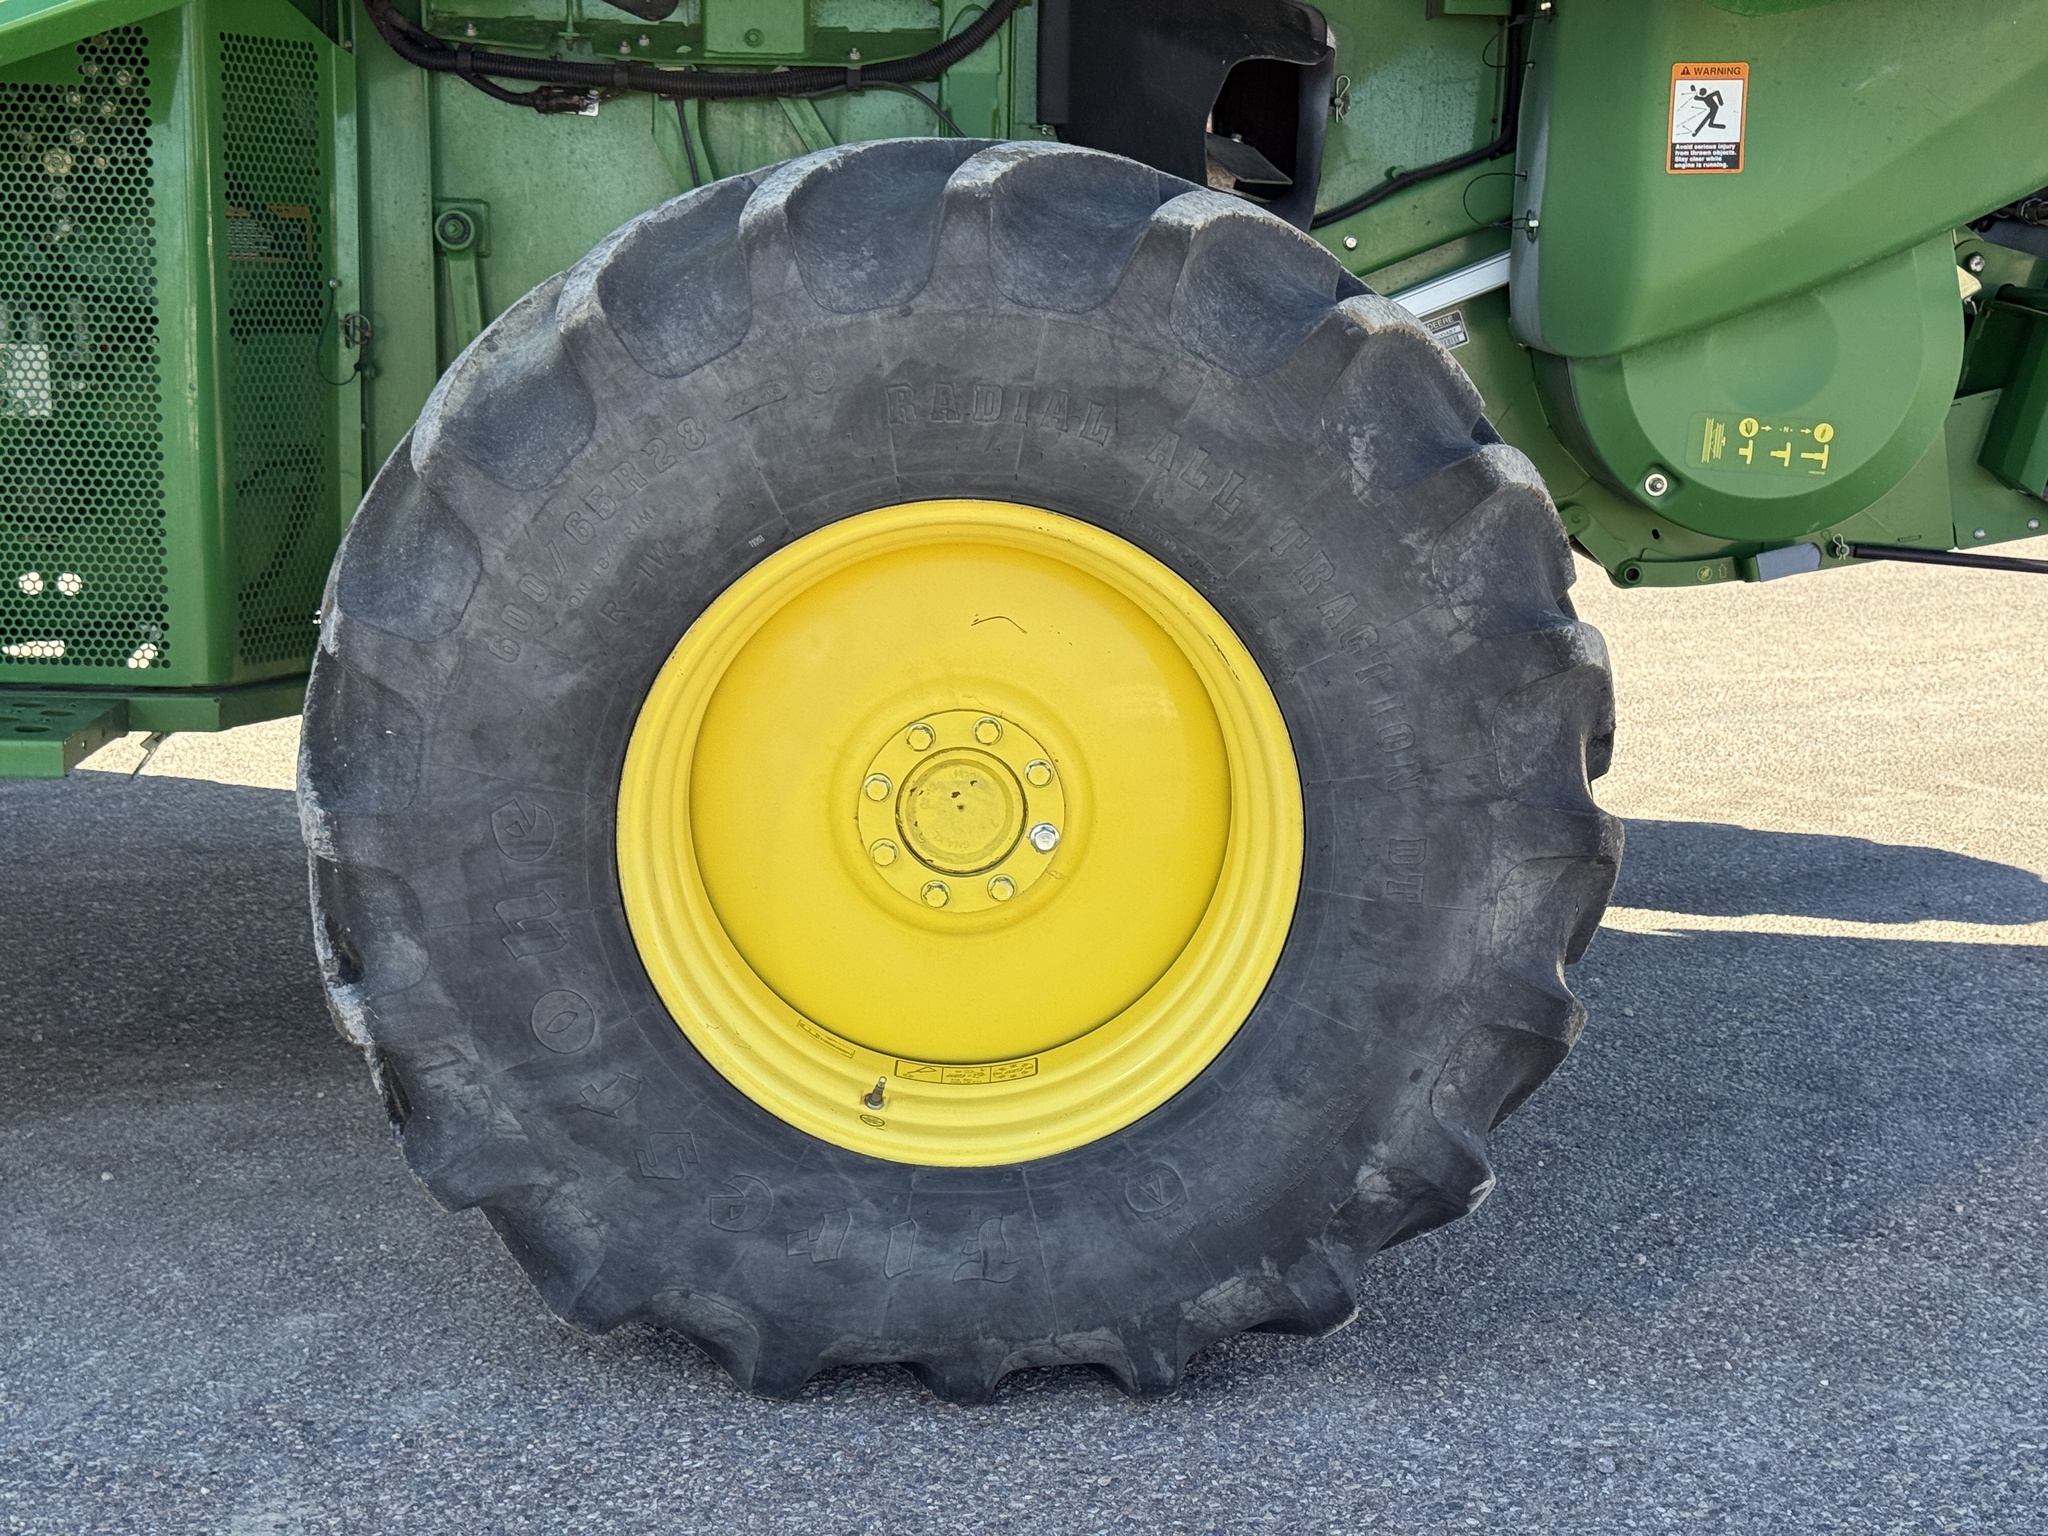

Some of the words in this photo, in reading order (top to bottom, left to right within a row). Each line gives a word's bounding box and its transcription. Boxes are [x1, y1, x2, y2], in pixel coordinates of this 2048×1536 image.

[1694, 67, 1741, 75] WARNING
[1427, 315, 1454, 330] DEERE
[488, 416, 707, 663] 600/65R28
[567, 581, 593, 608] ON
[623, 507, 655, 541] RIM
[600, 540, 674, 626] R-1W
[885, 383, 1112, 446] RADIAL
[1145, 432, 1245, 516] ALL
[1270, 517, 1427, 791] TRACTION
[1386, 838, 1427, 904] DT
[490, 799, 1023, 1285] Firestone
[1282, 1162, 1317, 1197] WHEEL
